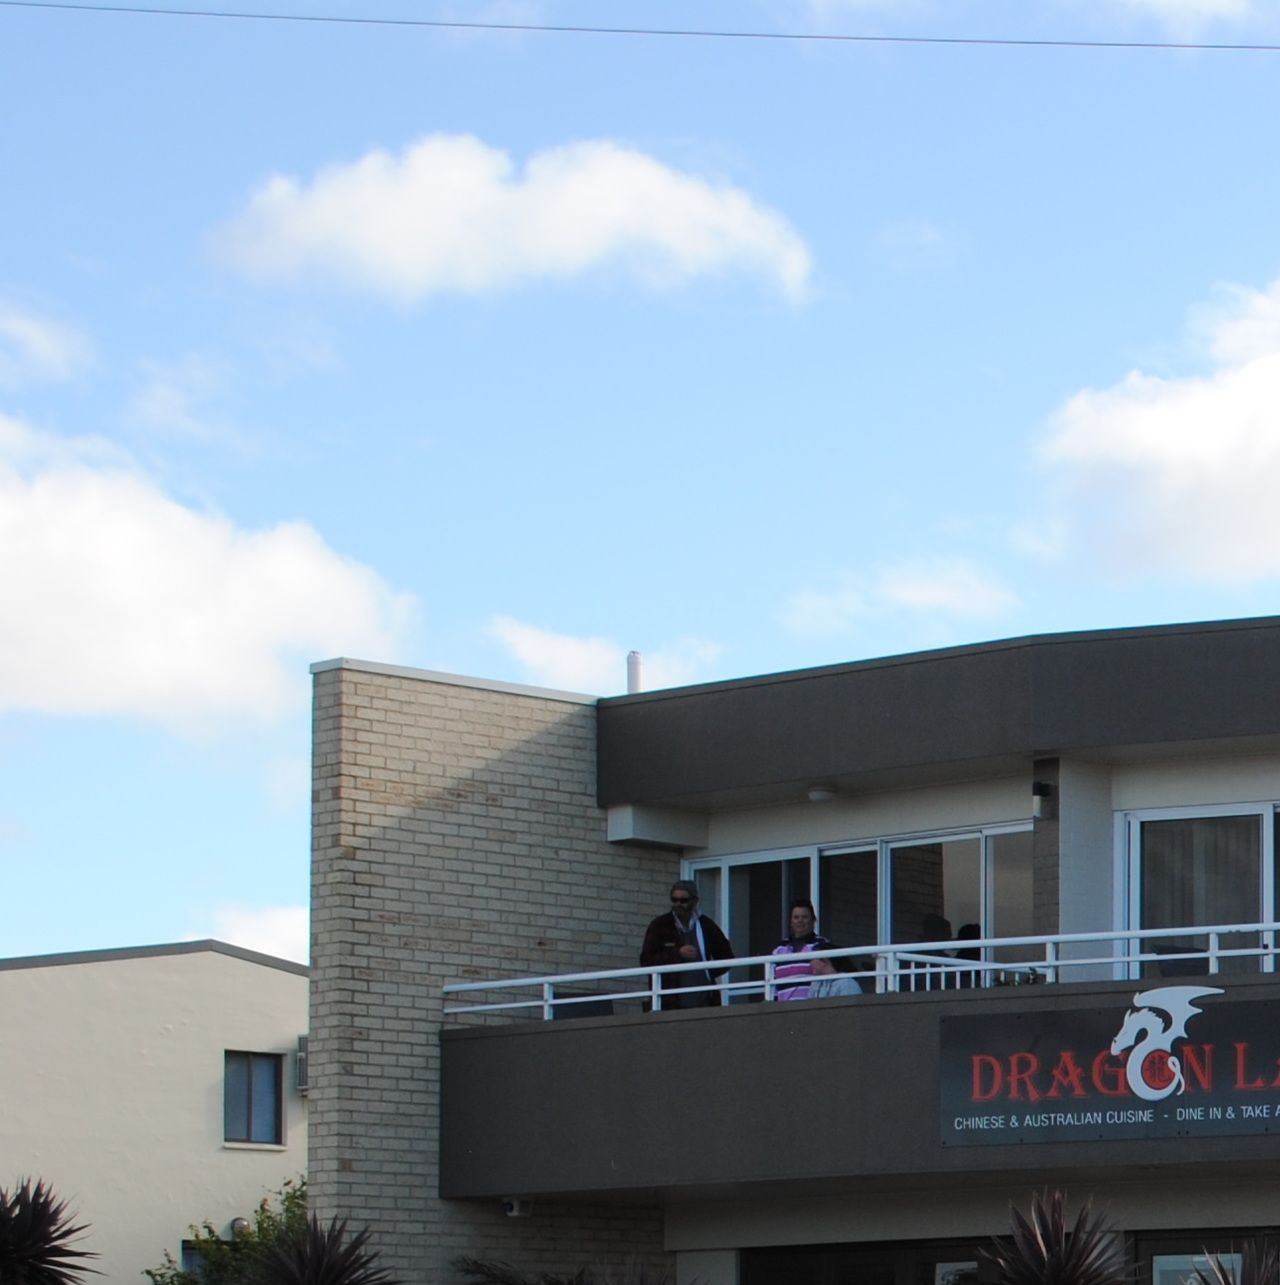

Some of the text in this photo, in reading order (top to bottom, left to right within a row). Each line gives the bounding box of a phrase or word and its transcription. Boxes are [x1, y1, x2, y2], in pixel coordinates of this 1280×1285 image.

[969, 1043, 1215, 1103] DRAGON
[954, 1115, 1006, 1131] CHINESE
[1009, 1114, 1019, 1128] &
[1023, 1110, 1103, 1128] AUSTRALIAN
[1106, 1108, 1155, 1124] CUISINE
[1176, 1106, 1205, 1121] DINE
[1209, 1105, 1222, 1120] IN
[1225, 1105, 1236, 1119] &
[1240, 1104, 1271, 1119] TAKE
